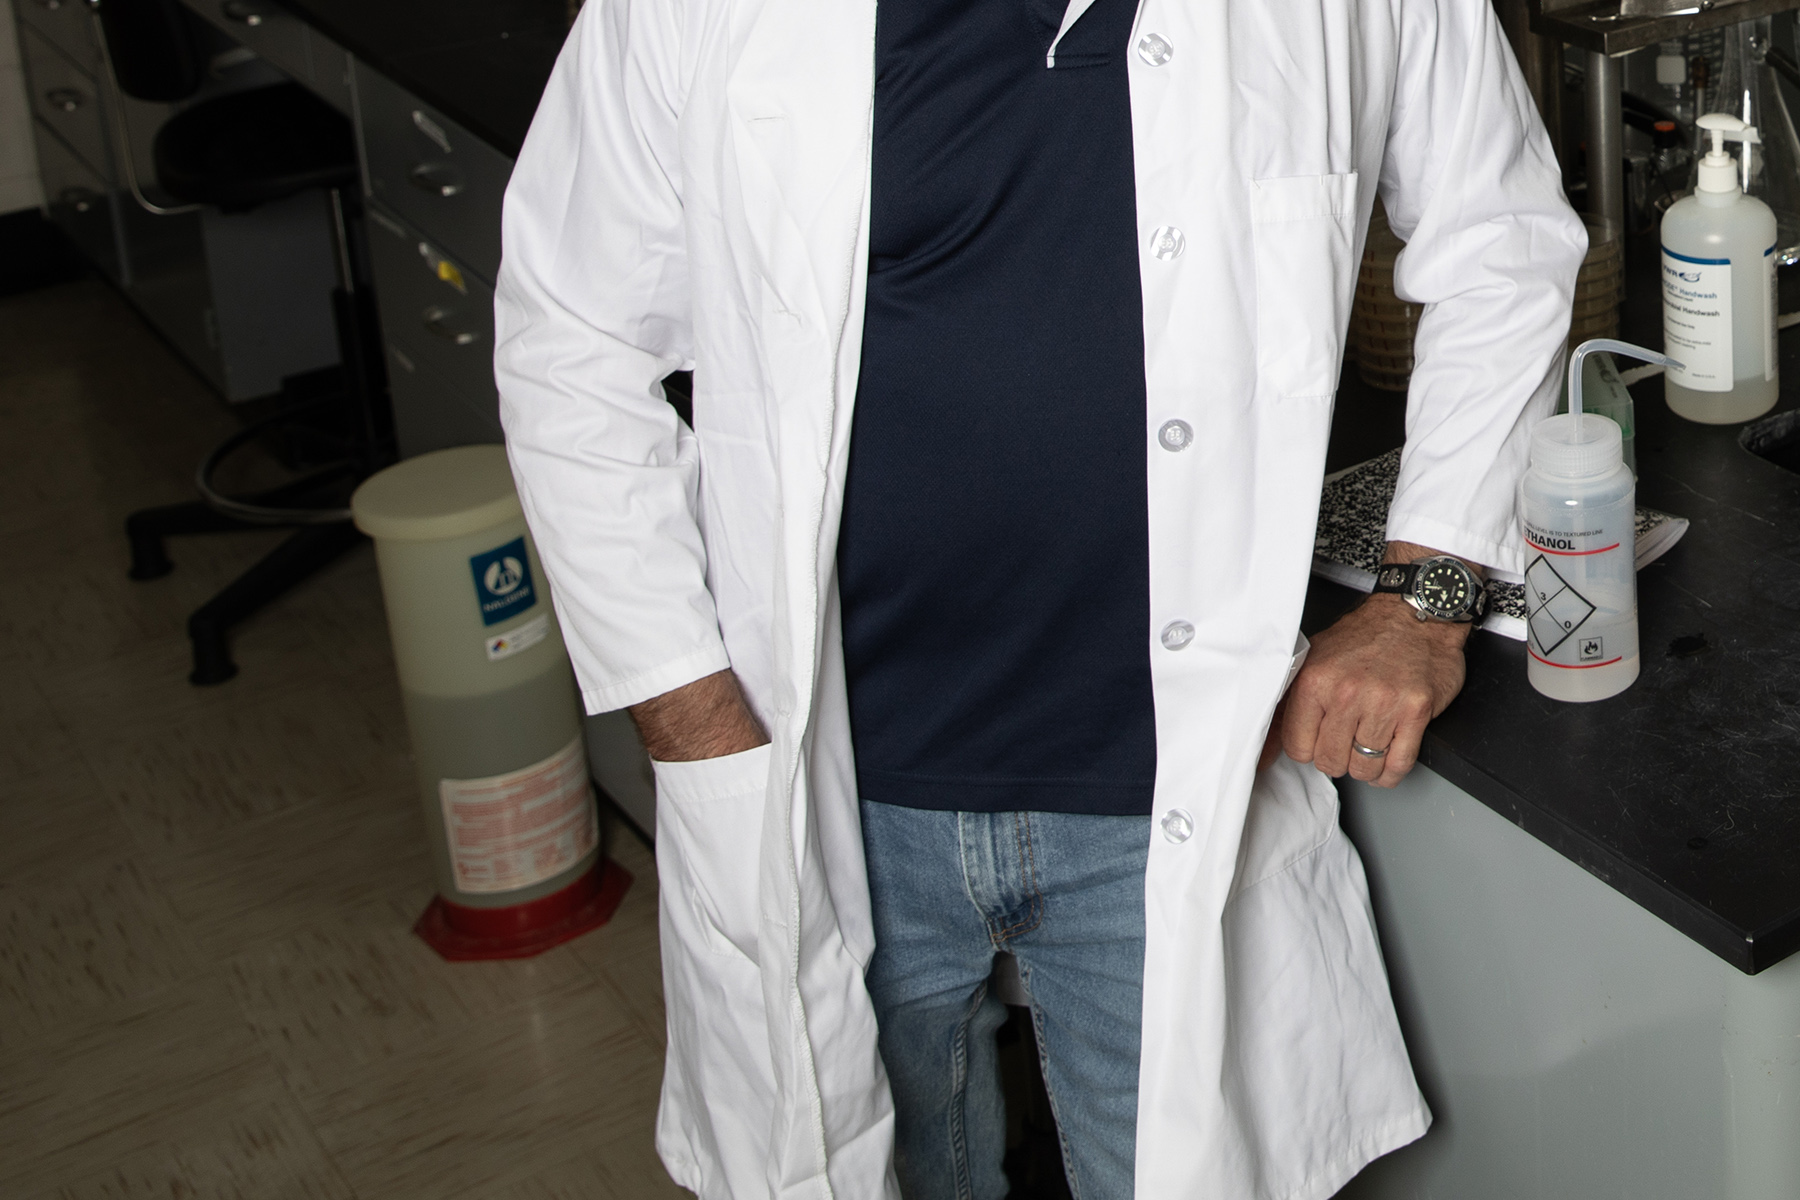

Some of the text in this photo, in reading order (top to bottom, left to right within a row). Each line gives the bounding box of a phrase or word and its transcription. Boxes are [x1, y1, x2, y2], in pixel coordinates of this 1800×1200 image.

[1679, 288, 1717, 299] Handwash
[1682, 306, 1720, 317] Handwash
[1541, 592, 1547, 601] 3
[1564, 621, 1571, 629] 0
